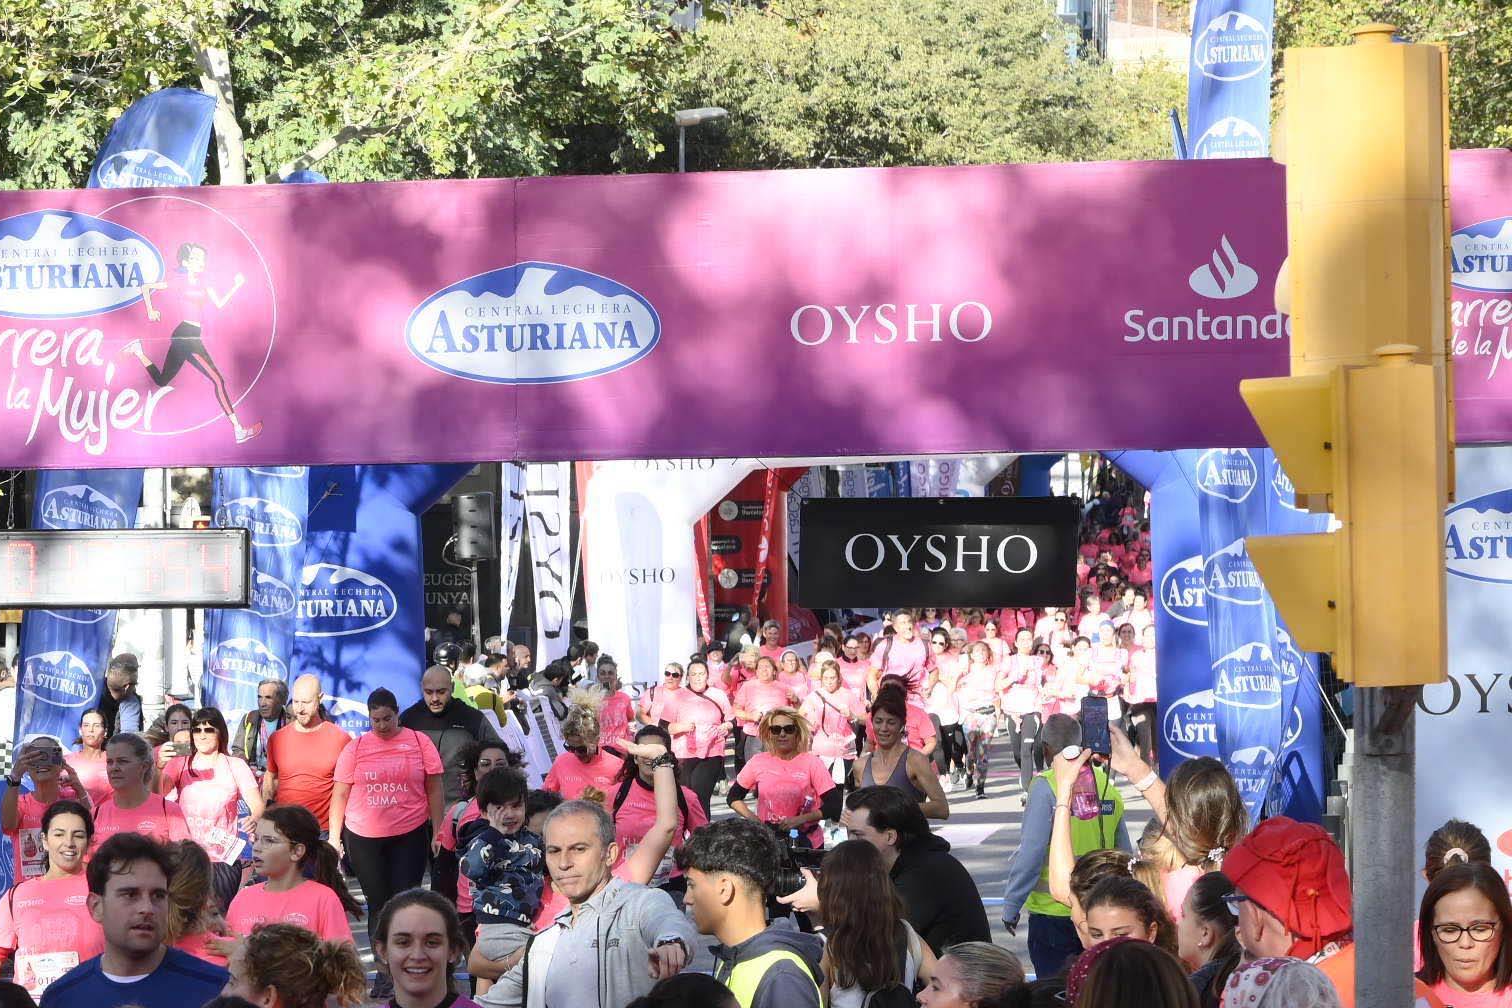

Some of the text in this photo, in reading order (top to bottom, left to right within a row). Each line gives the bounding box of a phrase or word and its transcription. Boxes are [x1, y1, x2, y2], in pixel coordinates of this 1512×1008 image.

[1203, 40, 1264, 65] ASTURIANA
[68, 246, 140, 258] LECHERA
[464, 302, 632, 317] CENTRAL LECHERA
[1452, 298, 1512, 328] arre
[426, 308, 640, 354] ASTURIANA
[790, 301, 993, 346] OYSHO
[6, 372, 32, 410] la
[25, 364, 175, 456] Mujer
[843, 532, 1040, 574] OYSHO
[599, 566, 677, 586] OYSHO
[299, 588, 329, 597] NTRAL
[1416, 672, 1512, 717] OY
[364, 771, 377, 781] TU
[366, 783, 409, 793] DORSAL
[367, 795, 398, 806] SUMA
